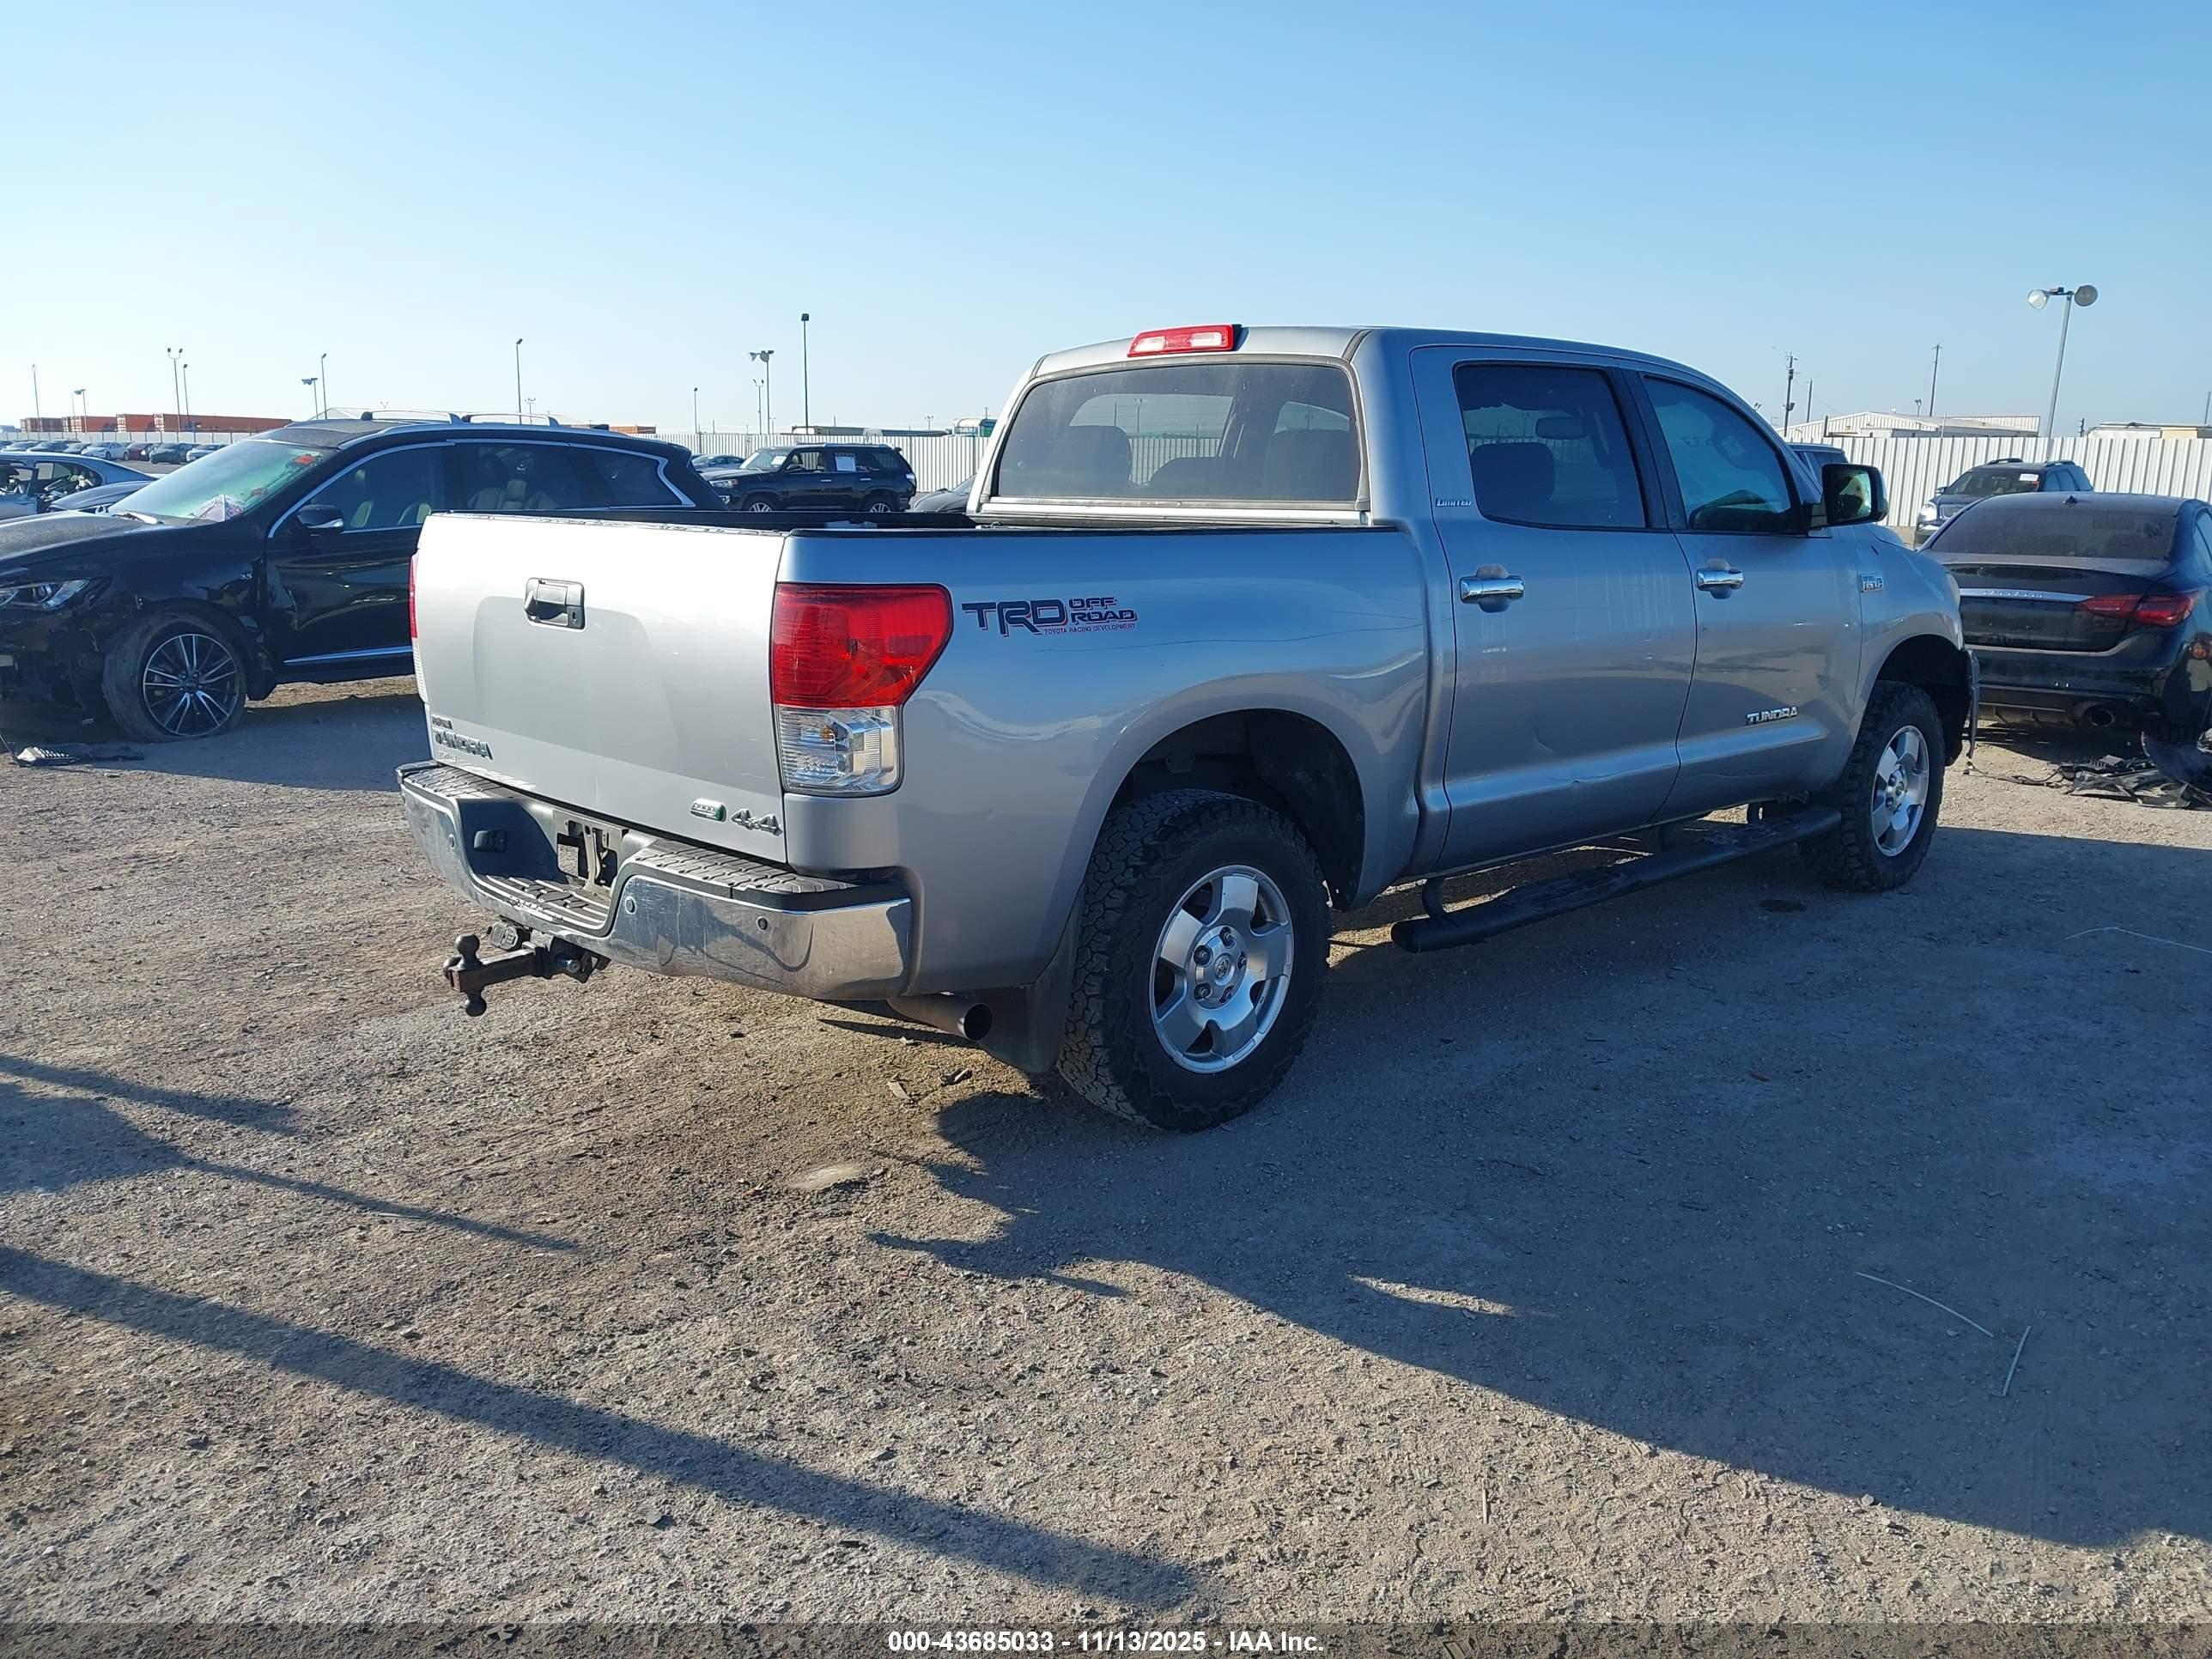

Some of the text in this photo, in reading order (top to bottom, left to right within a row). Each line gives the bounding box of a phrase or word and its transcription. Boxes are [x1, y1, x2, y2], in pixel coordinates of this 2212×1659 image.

[961, 599, 1068, 637] TRD
[1070, 610, 1138, 625] ROAD
[1069, 624, 1091, 633] RACING
[1093, 623, 1135, 632] DEVELOPMENT
[1746, 706, 1798, 724] TUNDRA
